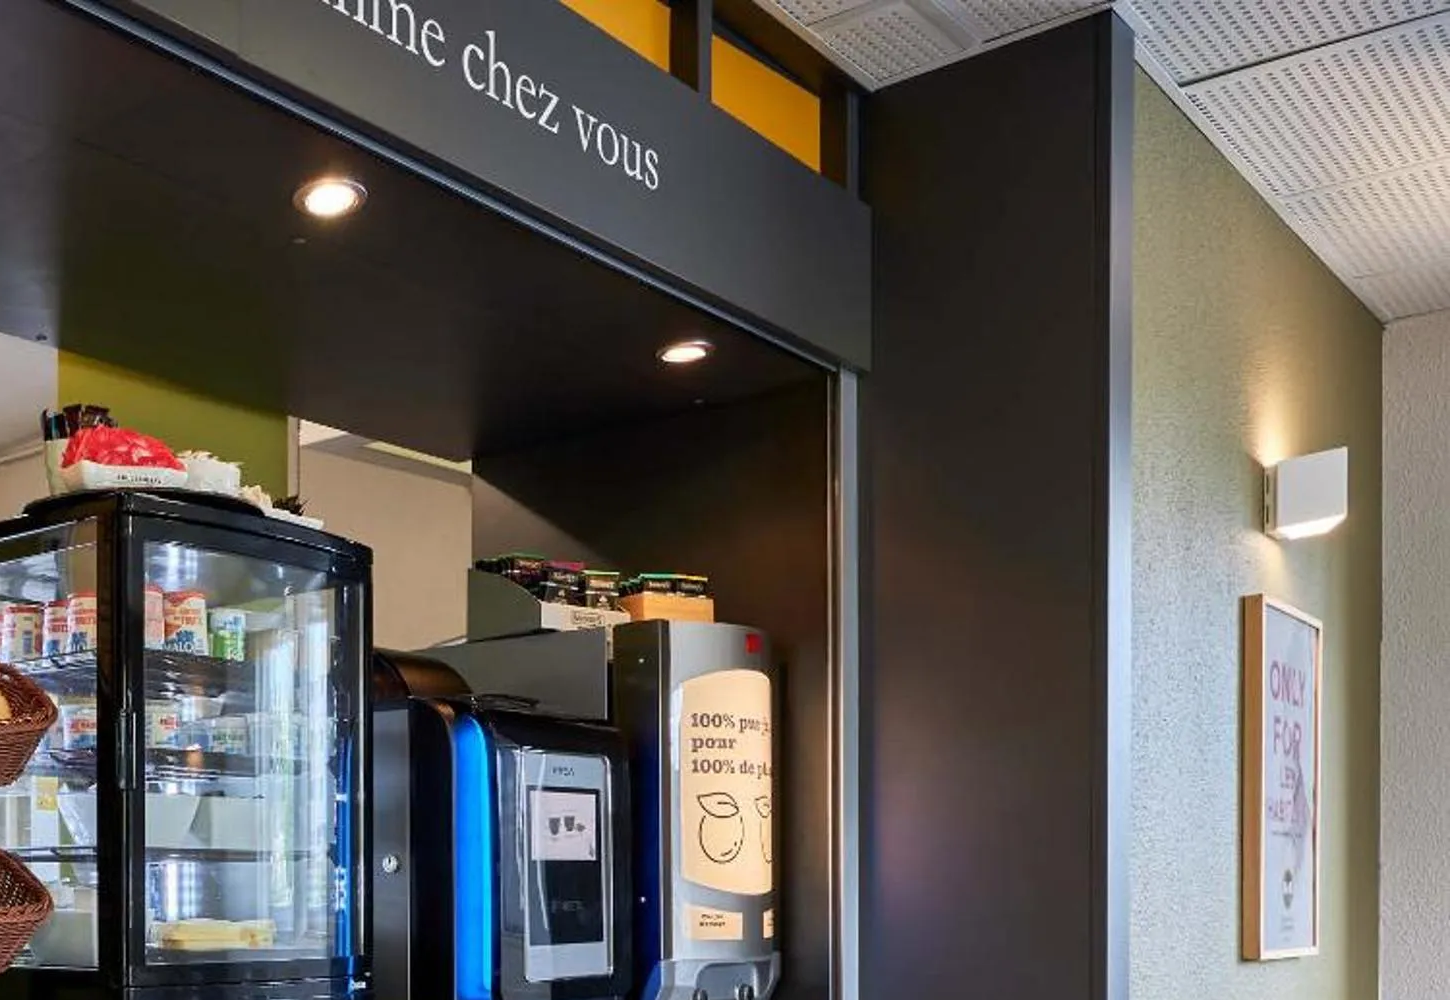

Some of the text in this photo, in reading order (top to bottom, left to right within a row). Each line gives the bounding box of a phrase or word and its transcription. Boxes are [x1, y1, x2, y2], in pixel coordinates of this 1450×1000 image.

[462, 30, 560, 134] chez
[571, 104, 660, 191] vous
[1269, 660, 1306, 709] ONLY
[691, 712, 736, 729] 100%
[691, 737, 737, 753] pour
[1272, 715, 1303, 759] FOR
[691, 759, 736, 774] 100%
[739, 760, 755, 775] de
